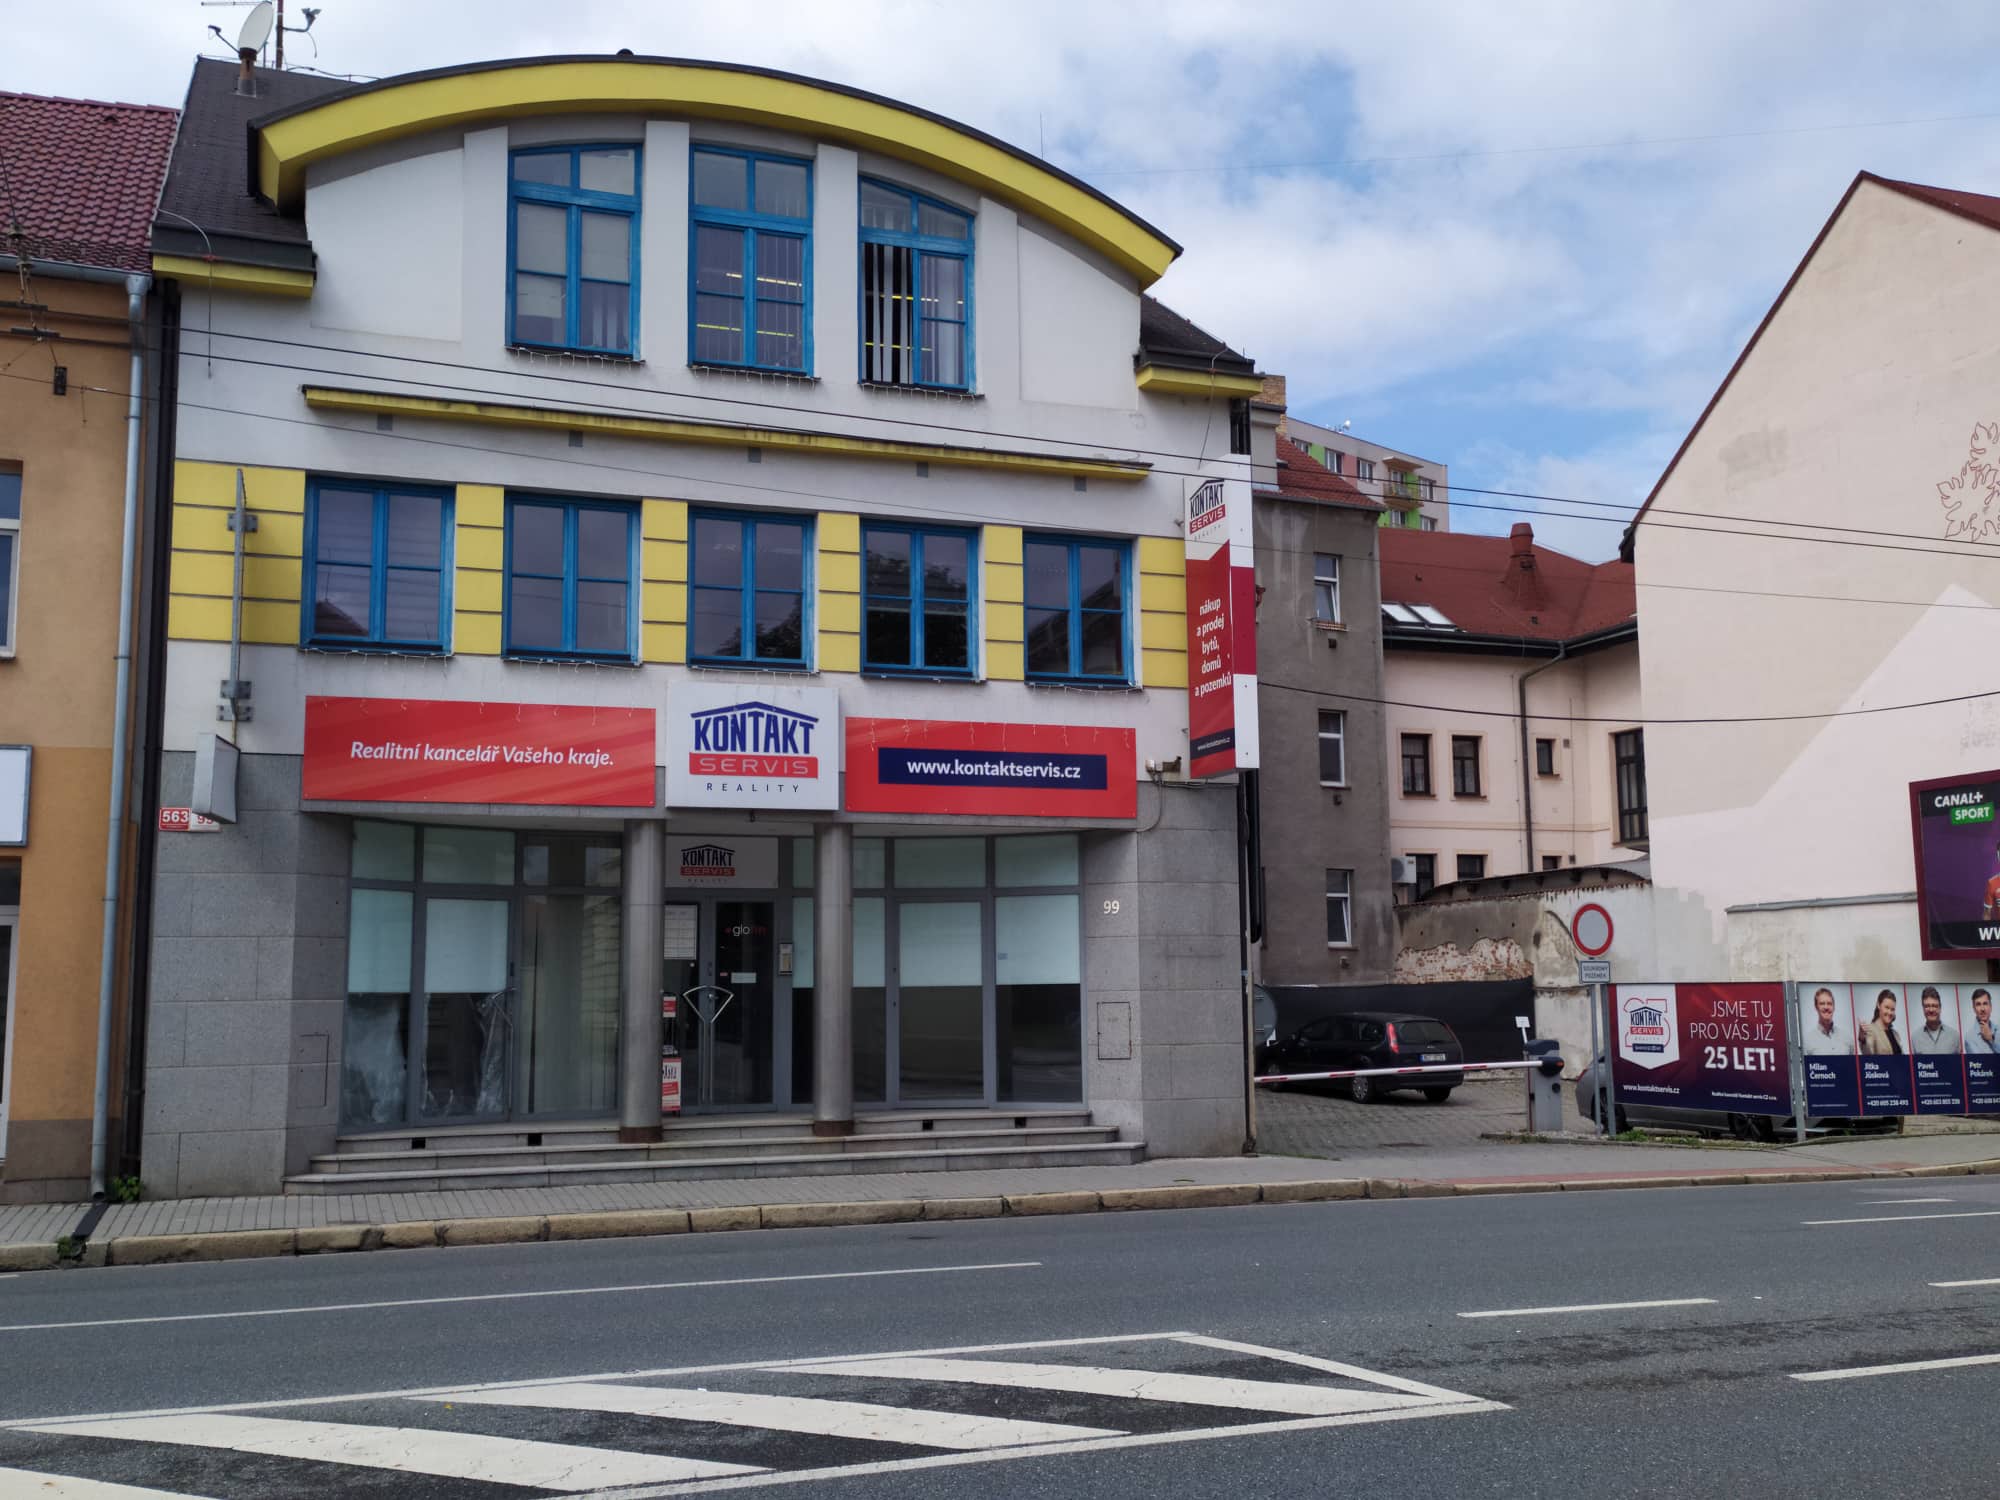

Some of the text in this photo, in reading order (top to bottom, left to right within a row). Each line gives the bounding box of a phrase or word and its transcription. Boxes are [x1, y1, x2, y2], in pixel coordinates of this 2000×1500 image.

[1190, 484, 1224, 520] KONTAKT
[1191, 507, 1224, 532] SERVIS
[1200, 598, 1221, 616] nákup
[1196, 613, 1224, 637] a prodej
[1202, 636, 1220, 655] bytů,
[1201, 655, 1221, 674] domů
[1194, 672, 1231, 697] a pozemků
[694, 710, 815, 754] KONTAKT
[350, 741, 615, 769] Realitní kancelář Vašeho kraje.
[699, 757, 809, 775] SERVIS
[906, 759, 1081, 779] www.kontaktservis.cz
[706, 783, 800, 793] REALITY
[1934, 791, 1984, 808] CANAL+
[162, 811, 189, 823] 563
[1954, 806, 1990, 821] SPORT
[682, 848, 735, 867] KONTAKT
[1103, 900, 1120, 914] 99
[1630, 1009, 1662, 1026] KONTAKT
[1711, 1000, 1772, 1018] JSME TU
[1690, 1019, 1774, 1041] PRO VÁS JIŽ
[1704, 1046, 1776, 1072] 25 LET!
[1809, 1063, 1828, 1071] Milan
